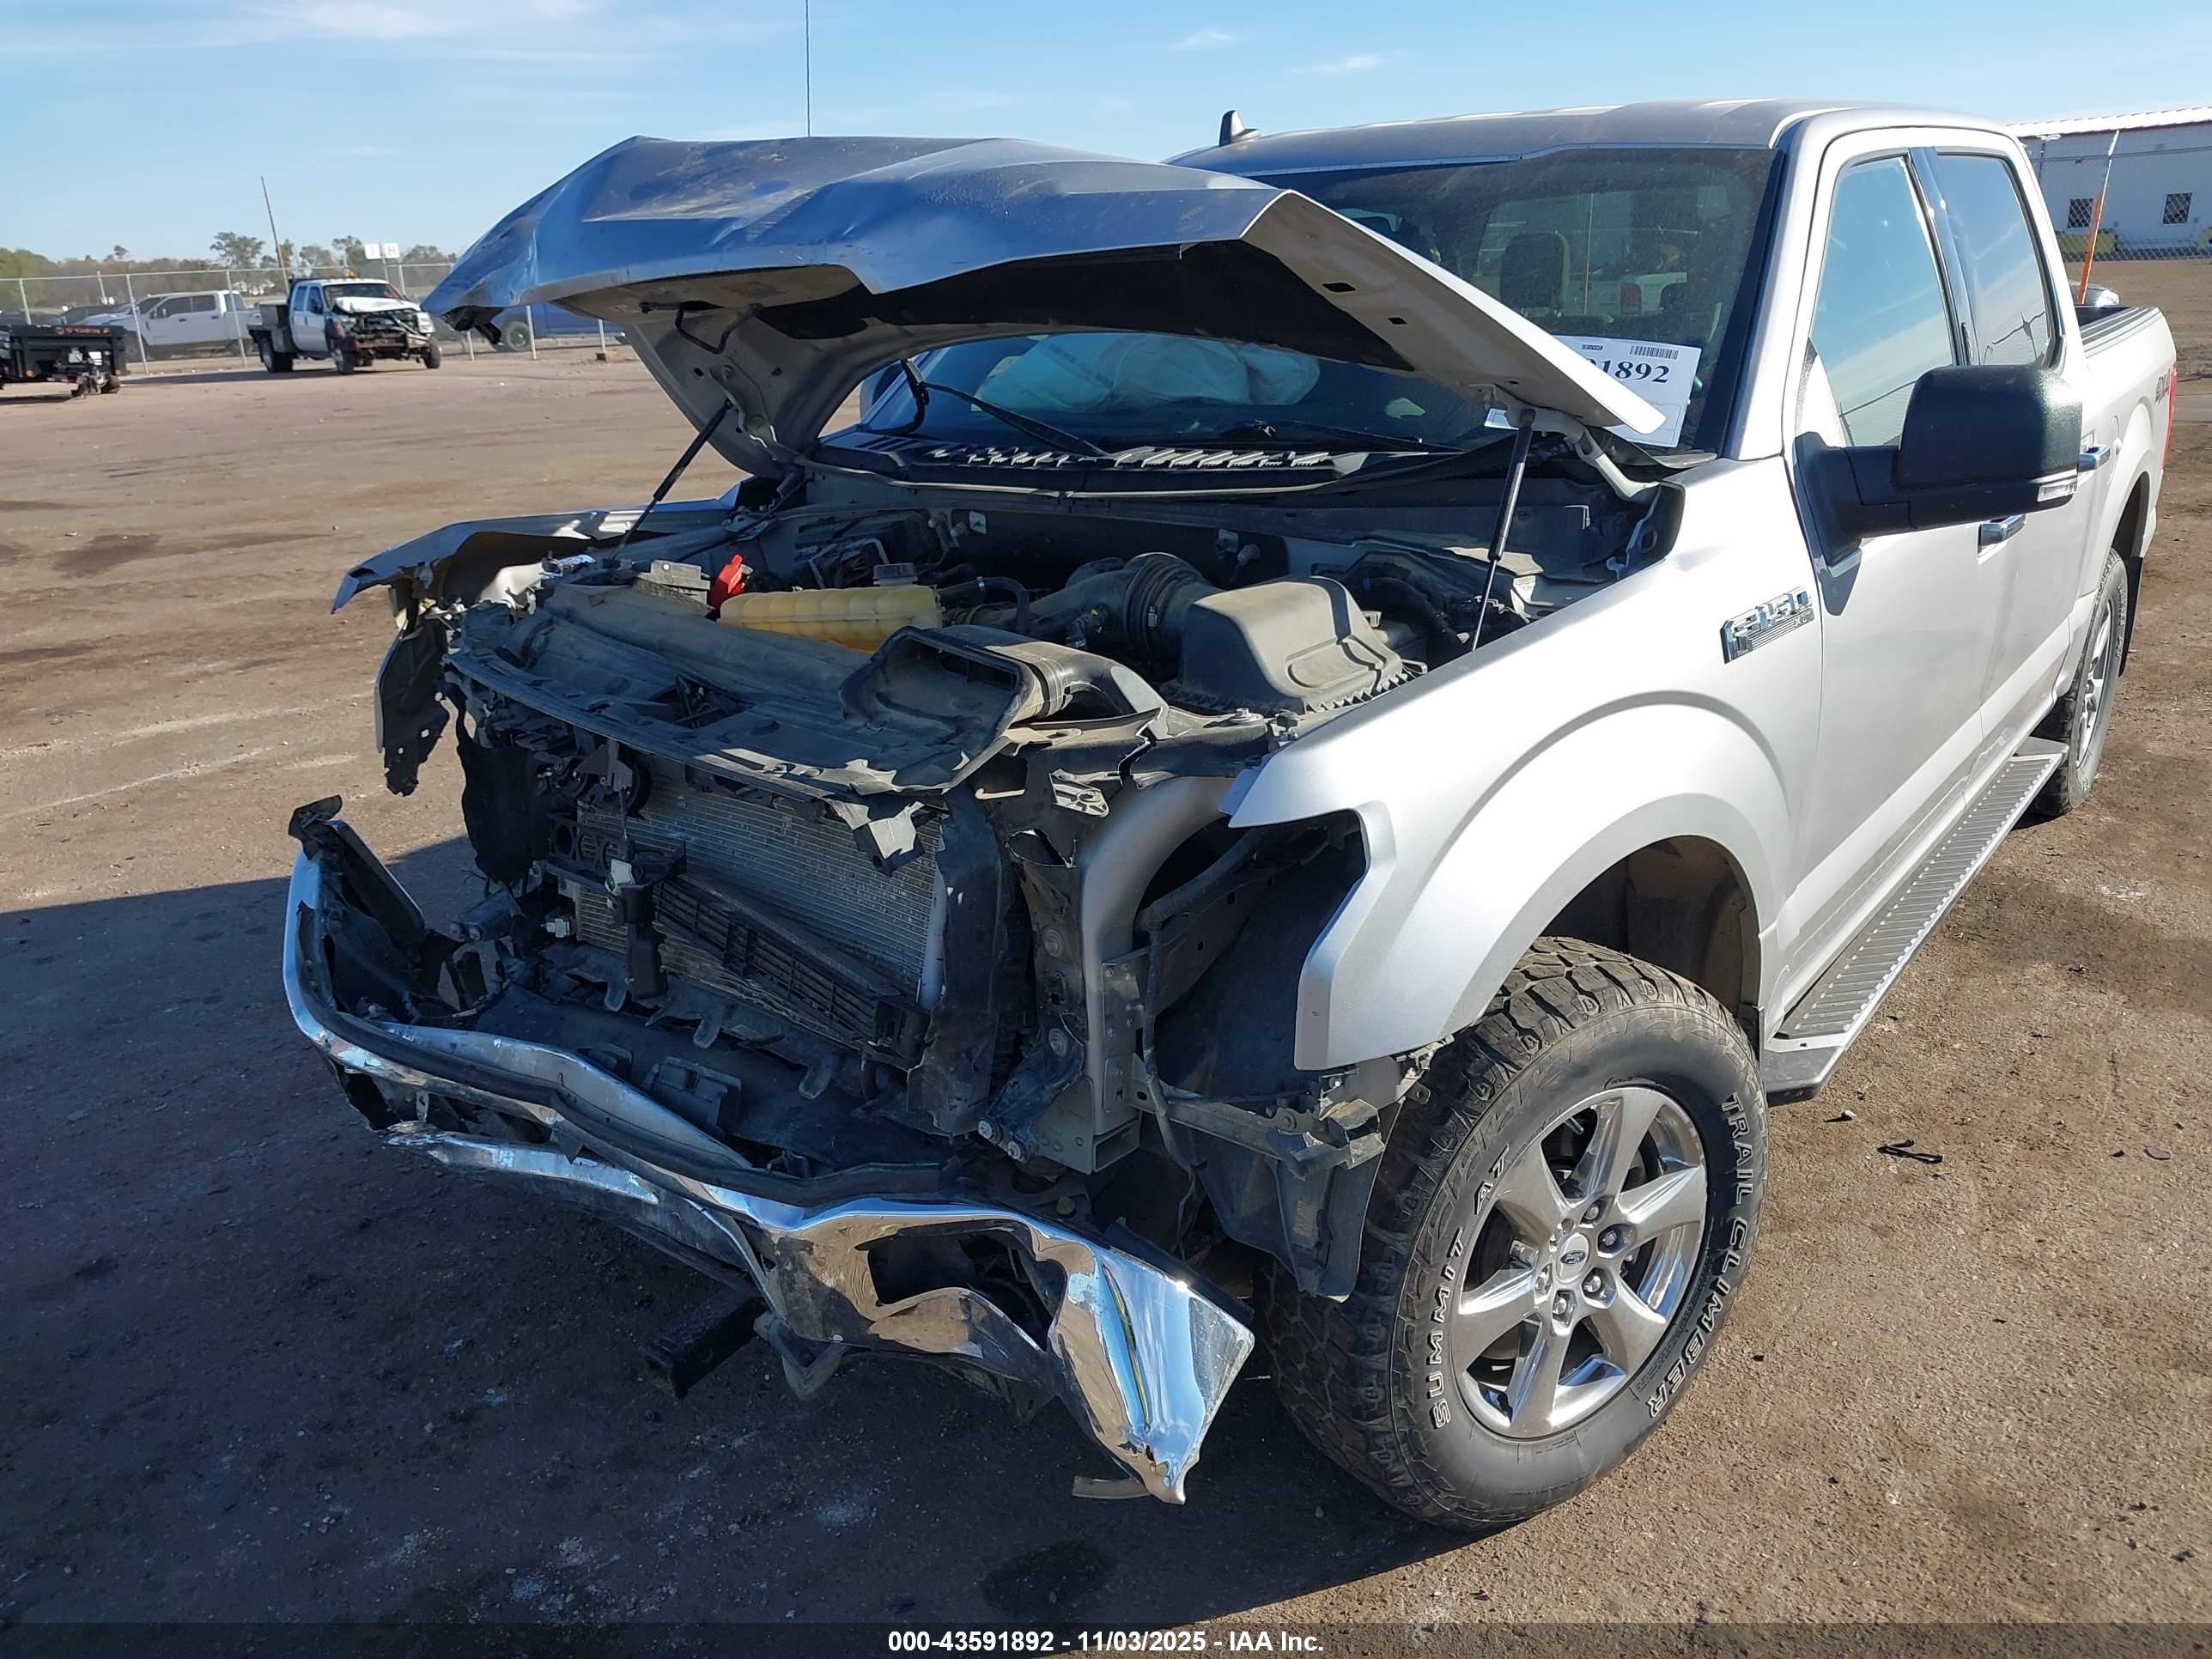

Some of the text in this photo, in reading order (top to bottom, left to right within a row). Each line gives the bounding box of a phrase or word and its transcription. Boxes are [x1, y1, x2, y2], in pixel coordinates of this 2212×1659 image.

[1721, 1091, 1753, 1205] TRAIL
[1426, 1143, 1509, 1430] SUMMIT AT
[1645, 1216, 1748, 1419] CLIMBER
